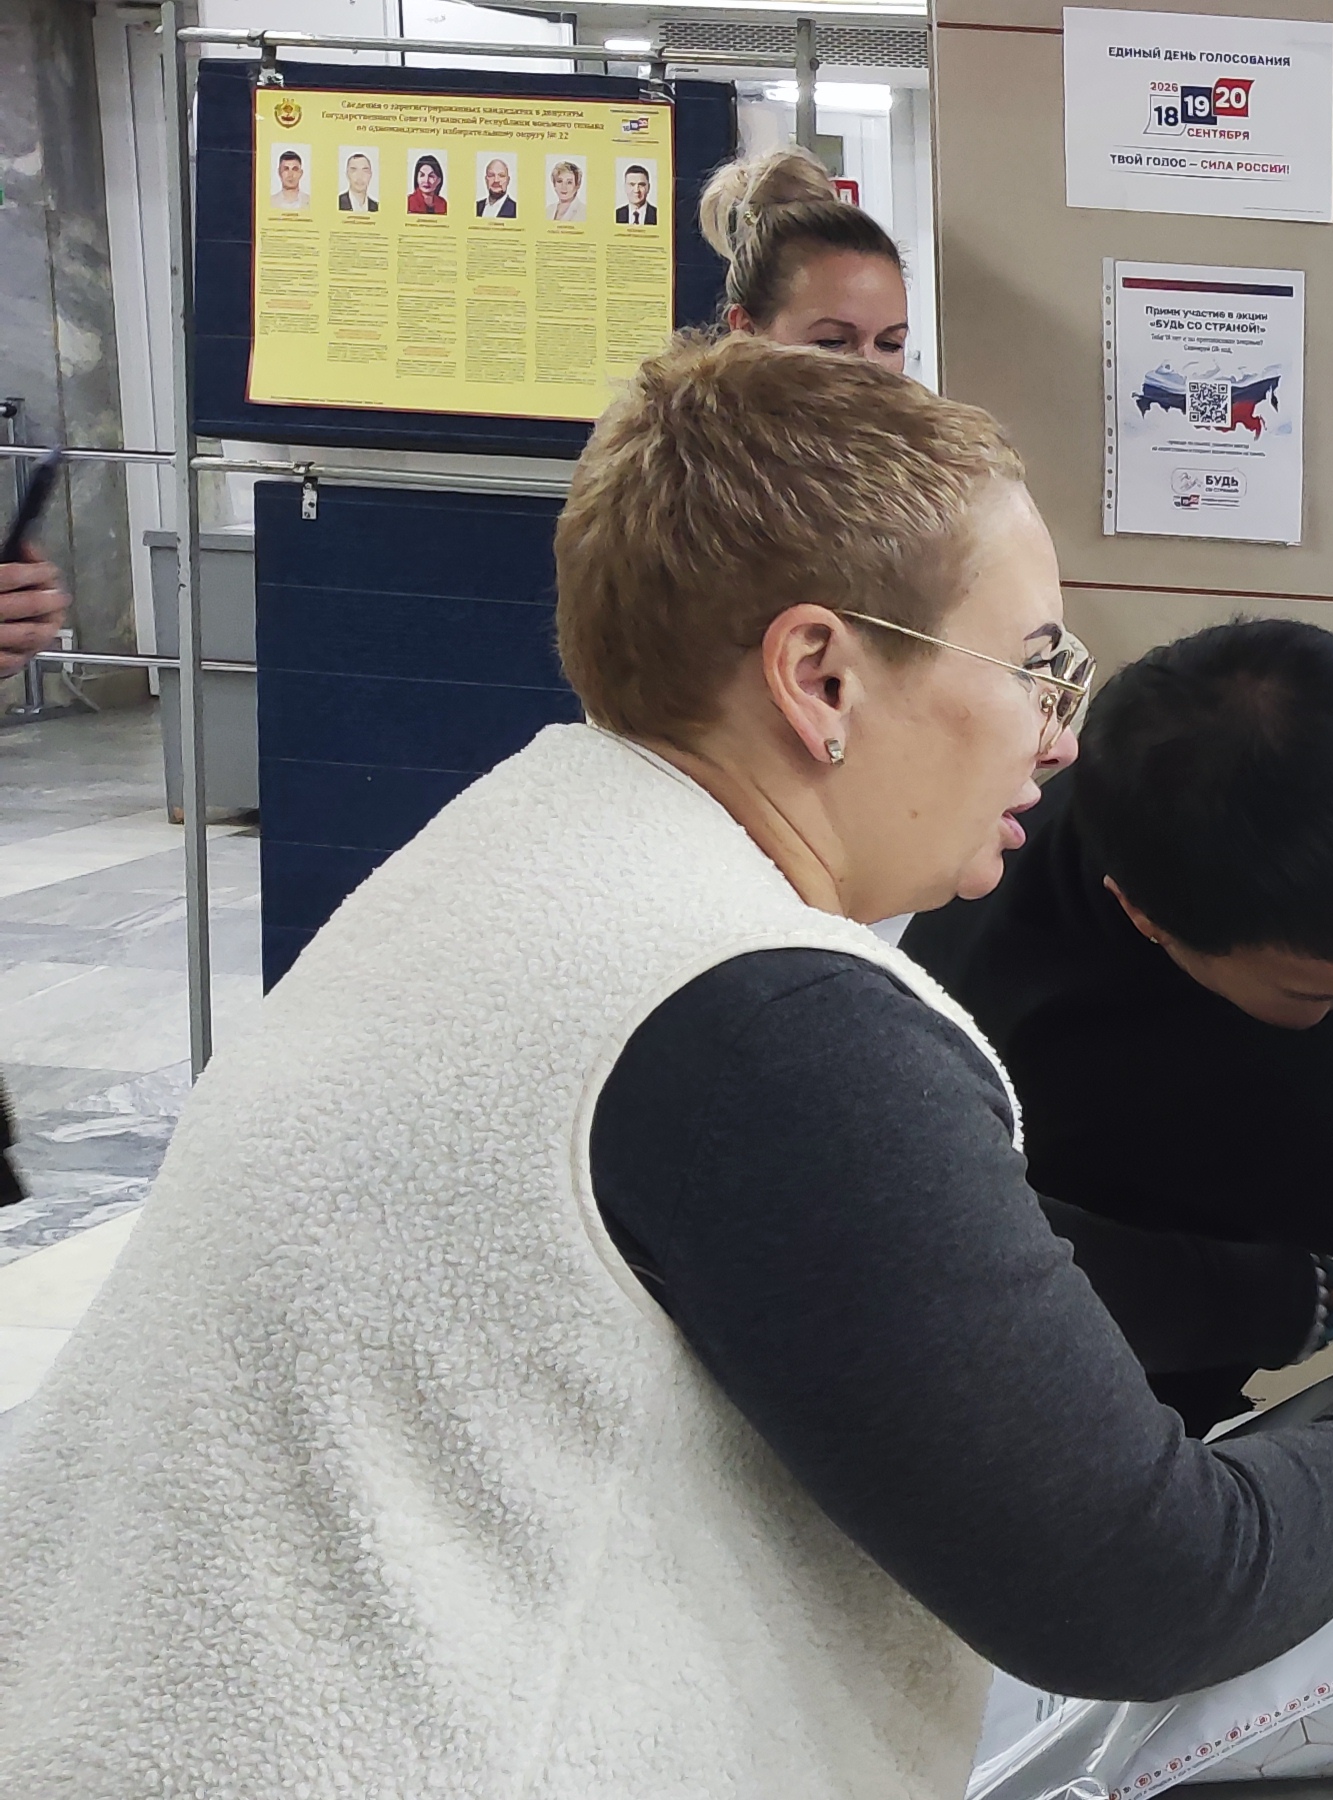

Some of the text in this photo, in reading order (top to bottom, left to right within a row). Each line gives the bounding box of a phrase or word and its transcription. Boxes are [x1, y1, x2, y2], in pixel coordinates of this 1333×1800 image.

[1108, 46, 1291, 67] ЕДИНЫЙ ДЕНЬ ГОЛОСОВАНИЯ
[1150, 82, 1179, 92] 2026
[1153, 87, 1246, 126] 18 19 20
[1187, 128, 1250, 141] СЕНТЯБРЯ
[1110, 153, 1143, 165] ТВОЙ
[1146, 156, 1187, 168] ГОЛОС
[1200, 159, 1234, 171] СИЛА
[1236, 162, 1290, 174] РОССИИ!
[1145, 305, 1180, 317] Прими
[1182, 309, 1225, 319] участие
[1236, 312, 1268, 321] акции
[1149, 319, 1266, 334] «БУДЬ СО СТРАНОЙ!»
[1205, 475, 1239, 488] БУДЬ
